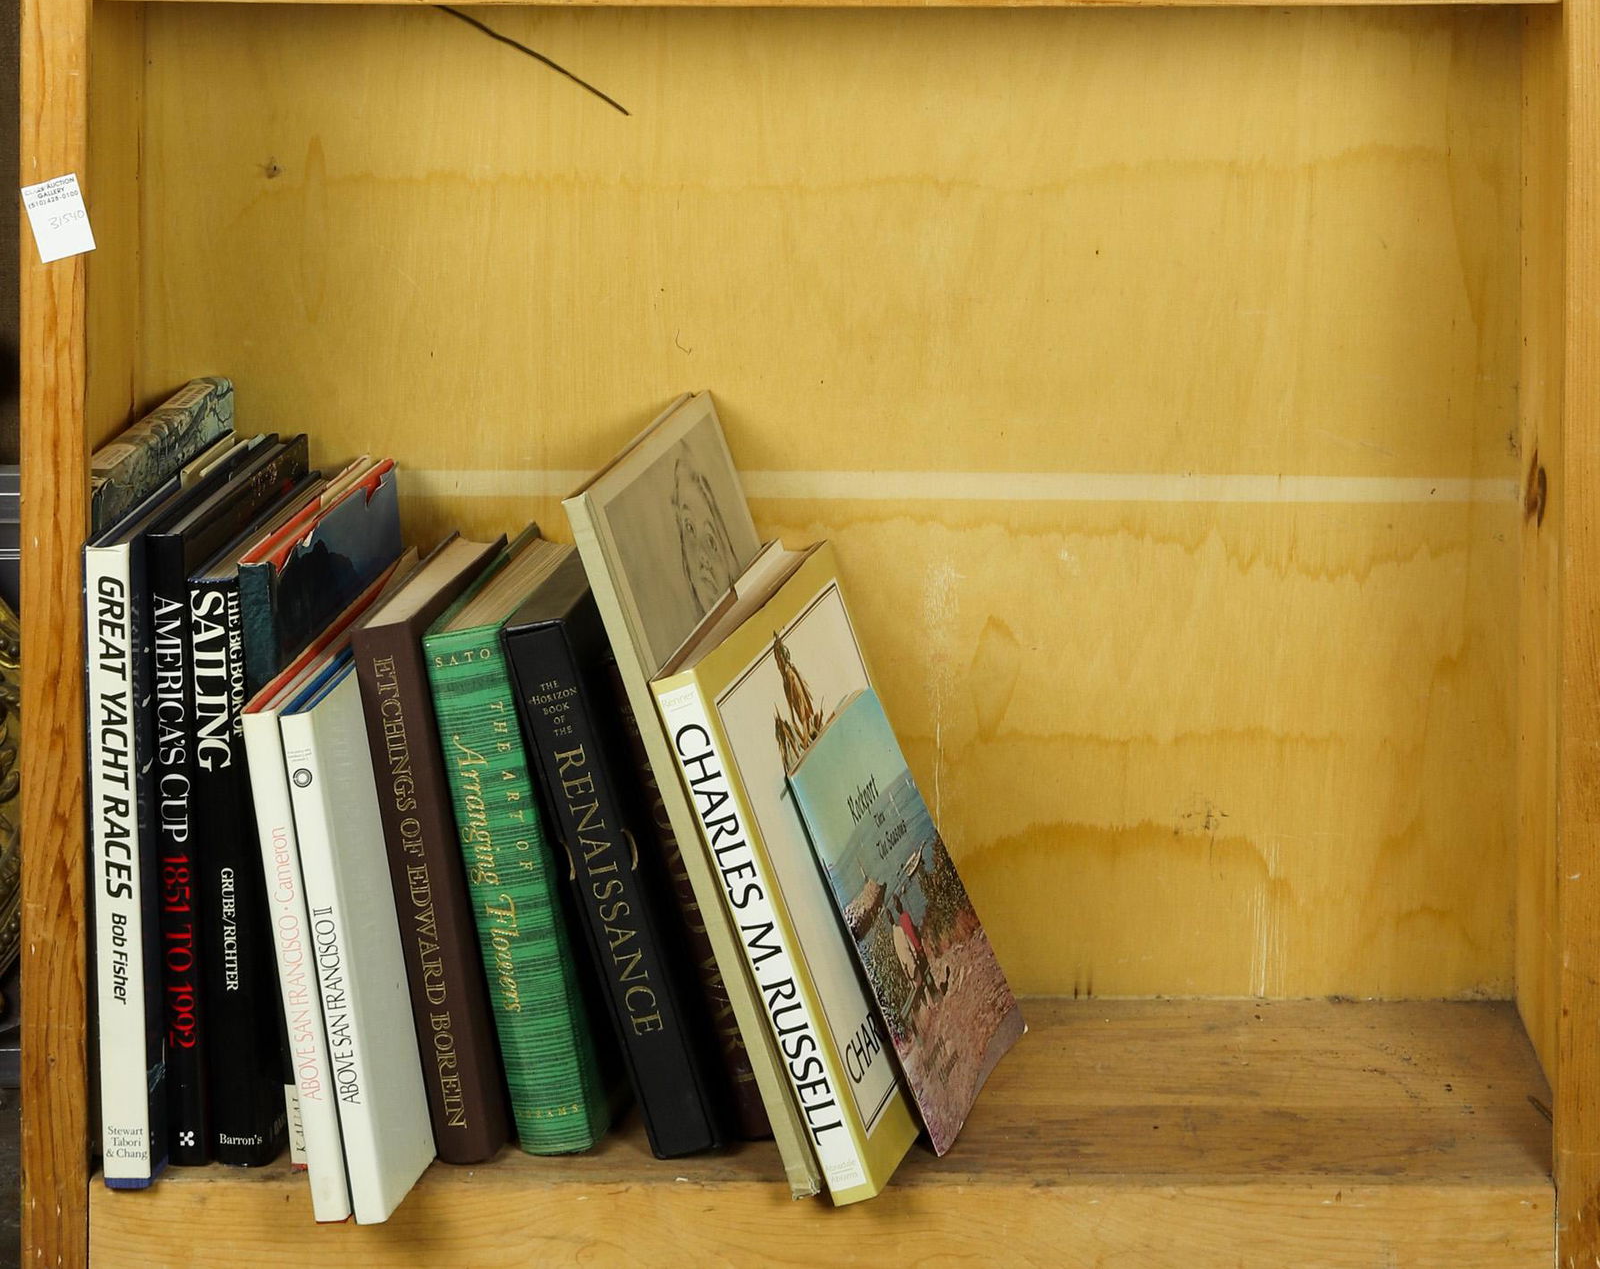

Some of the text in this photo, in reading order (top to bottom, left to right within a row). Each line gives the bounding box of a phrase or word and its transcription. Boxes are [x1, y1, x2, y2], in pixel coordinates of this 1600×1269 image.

[37, 187, 65, 199] GALLERY
[46, 177, 75, 189] AUCTION
[96, 574, 133, 899] GREAT YACHT RACES
[152, 592, 192, 842] AMERICA'S CUP
[187, 588, 231, 772] SAILING
[111, 912, 132, 1005] Bob Fisher
[159, 853, 196, 1049] 1851 TO 1992
[219, 866, 240, 991] GRUBE/RICHTER
[373, 655, 468, 1129] ETCHINGS OF EDWARD BOREIN
[452, 733, 524, 1012] Arranging Flowers
[552, 742, 664, 1037] RENAISSANCE
[674, 722, 844, 1146] CHARLES M. RUSSELL
[219, 1133, 263, 1146] Barron's
